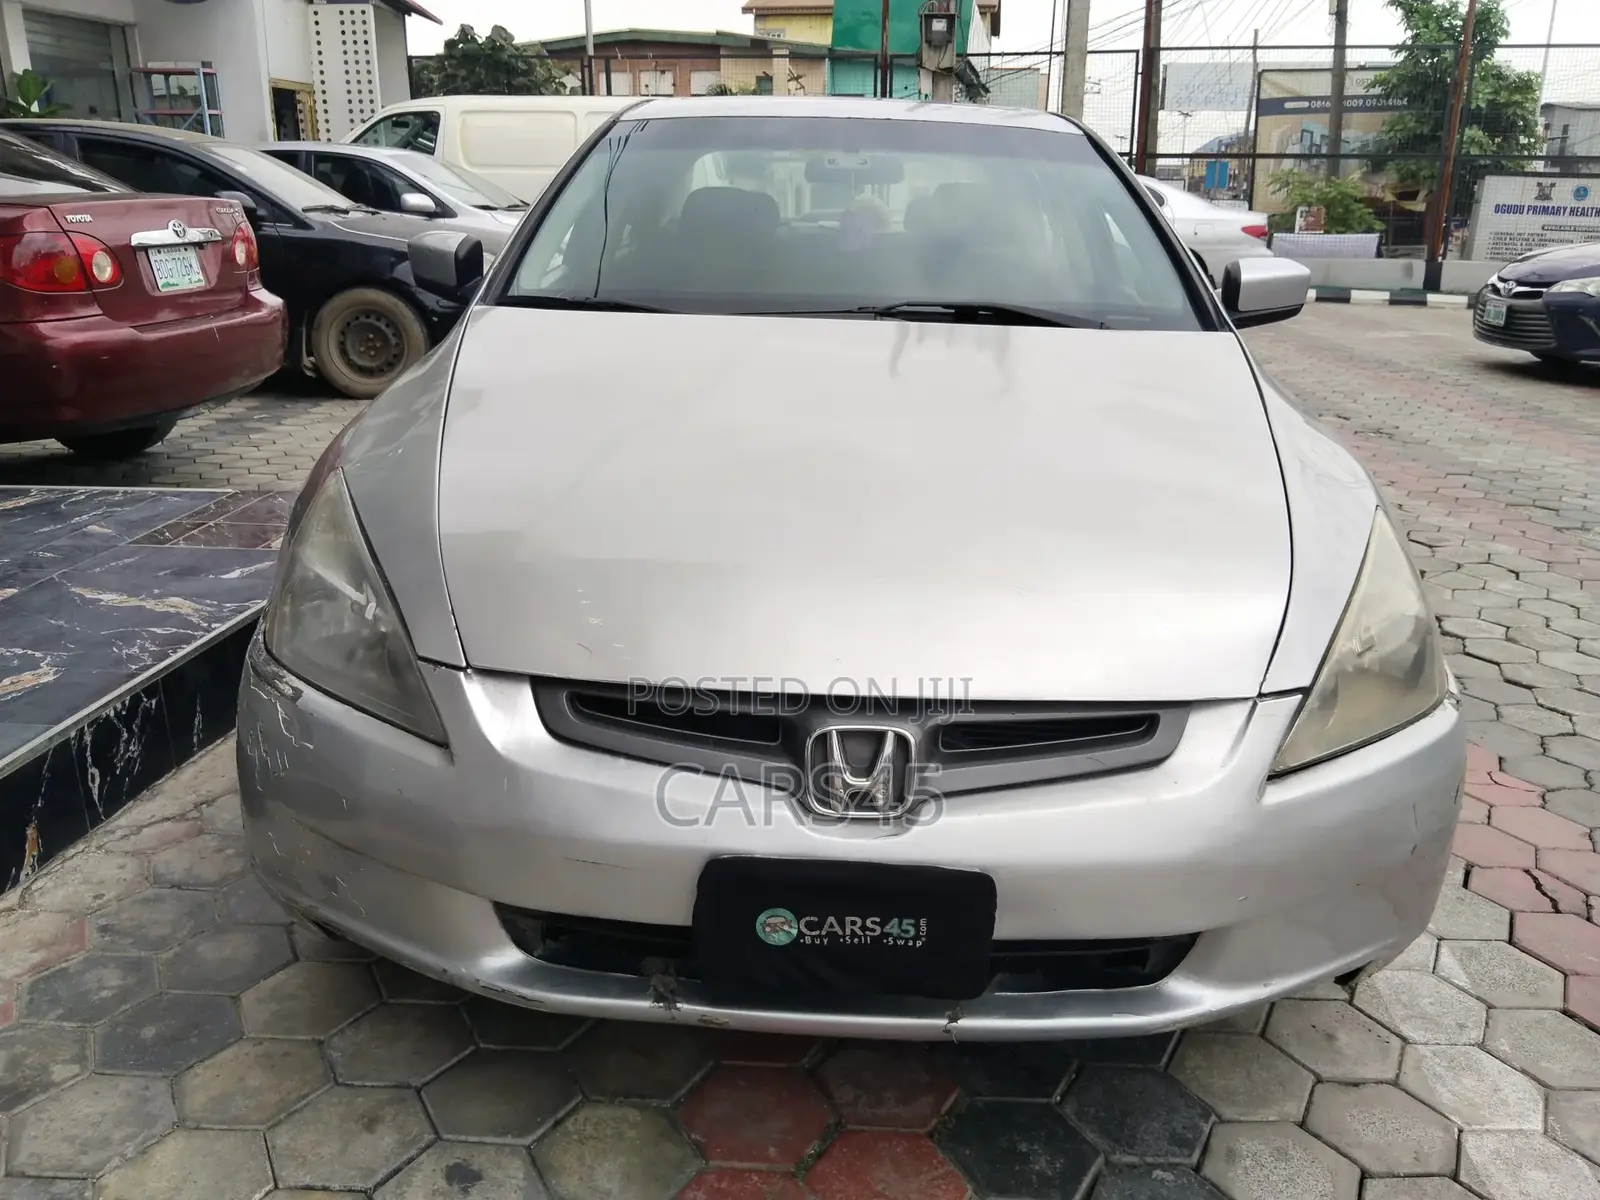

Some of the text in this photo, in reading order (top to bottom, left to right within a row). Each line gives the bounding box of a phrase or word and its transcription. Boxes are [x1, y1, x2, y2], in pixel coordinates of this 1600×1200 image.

[1494, 203, 1525, 215] OGUDU
[1526, 205, 1568, 216] PRIMARY
[65, 214, 92, 223] TOYOTA
[799, 916, 916, 938] CARS45
[805, 936, 923, 948] Buy Sell Swap
